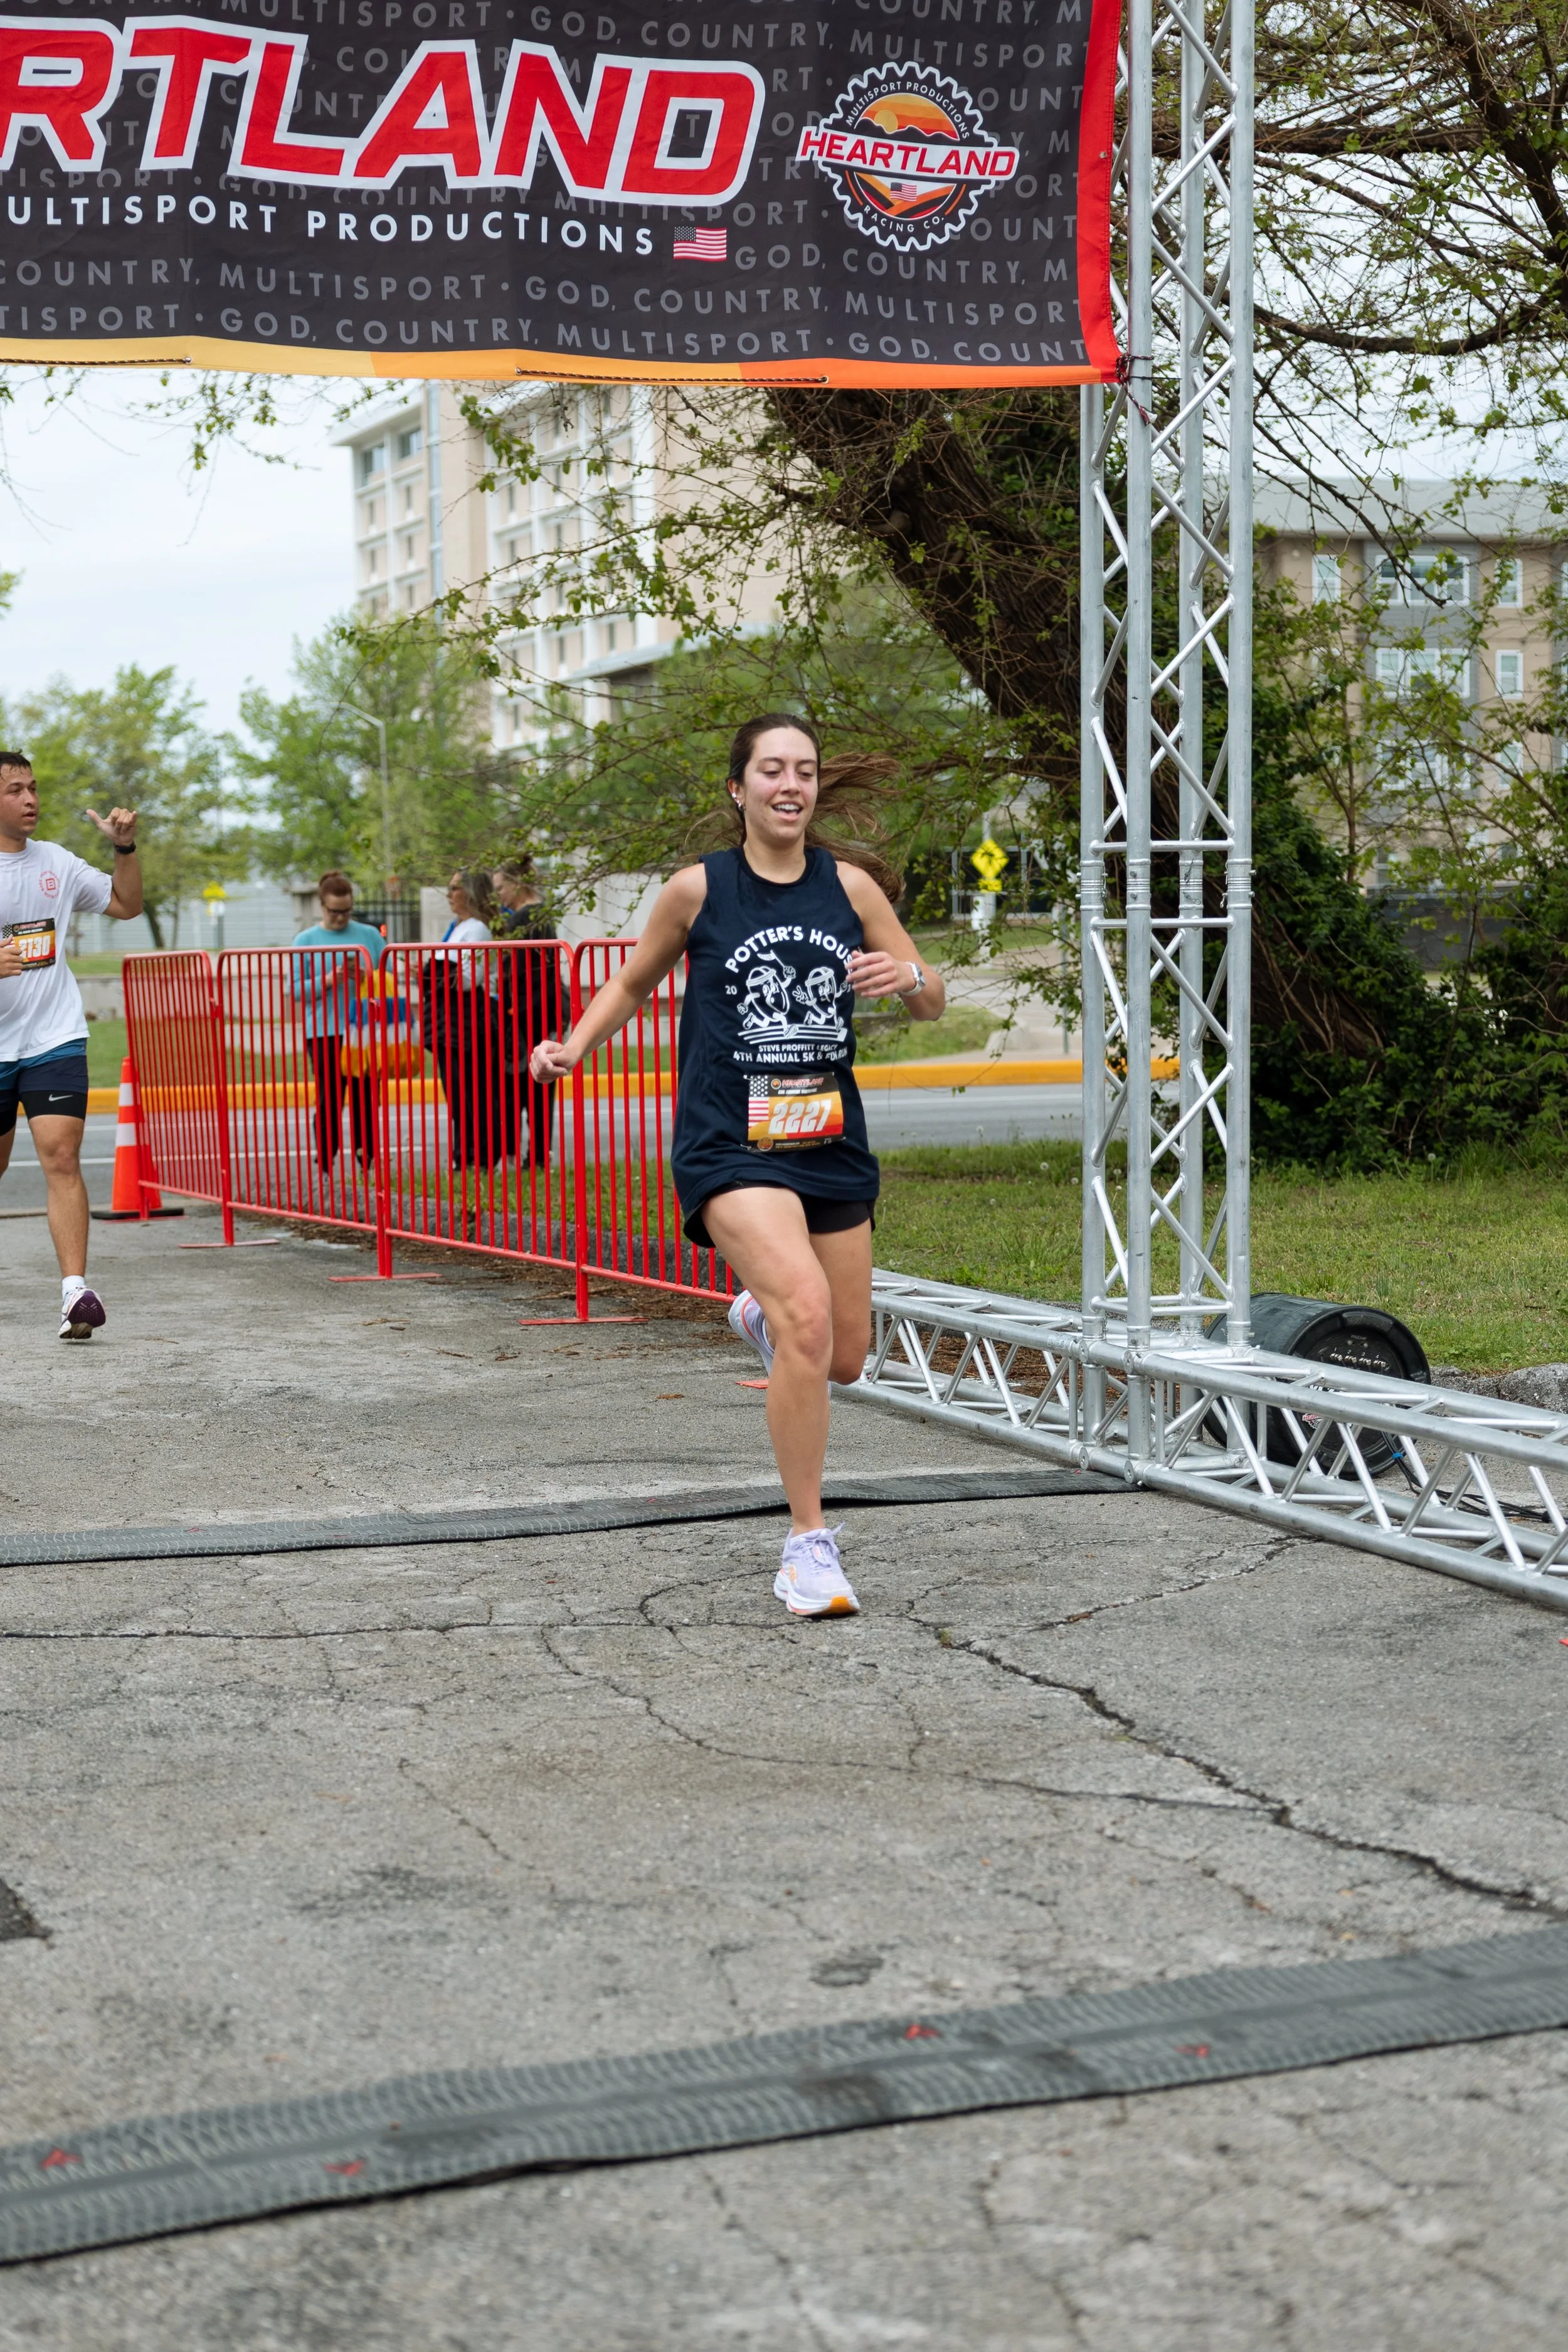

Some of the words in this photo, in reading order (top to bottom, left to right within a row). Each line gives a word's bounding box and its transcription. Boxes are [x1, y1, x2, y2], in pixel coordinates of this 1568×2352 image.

[531, 6, 621, 43] GOD,
[640, 21, 833, 50] COUNTRY,
[846, 82, 901, 127] MULTISPORT
[906, 81, 970, 139] PRODUCTIONS
[800, 131, 1016, 176] HEARTLAND
[7, 195, 277, 233] ULTISPORT
[307, 211, 653, 255] PRODUCTIONS
[863, 205, 914, 233] RACING
[923, 216, 944, 230] CO.
[735, 242, 827, 270] GOD,
[843, 248, 1025, 285] COUNTRY,
[0, 258, 200, 285] OUNTRY,
[220, 262, 486, 301] MULTISPORT
[526, 275, 617, 311] GOD,
[633, 285, 829, 314] COUNTRY,
[220, 307, 317, 342] GOD,
[336, 318, 539, 345] COUNTRY,
[557, 322, 811, 356] MULTISPORT
[849, 332, 938, 361] GOD,
[19, 935, 51, 959] 2130
[725, 926, 803, 973] POTTER'S
[809, 928, 852, 974] HOUS
[733, 1051, 753, 1062] 4TH
[756, 1053, 800, 1063] ANNUAL
[802, 1052, 815, 1061] 5K
[817, 1051, 822, 1060] &
[759, 1044, 780, 1052] STEVE
[768, 1099, 832, 1135] 2227
